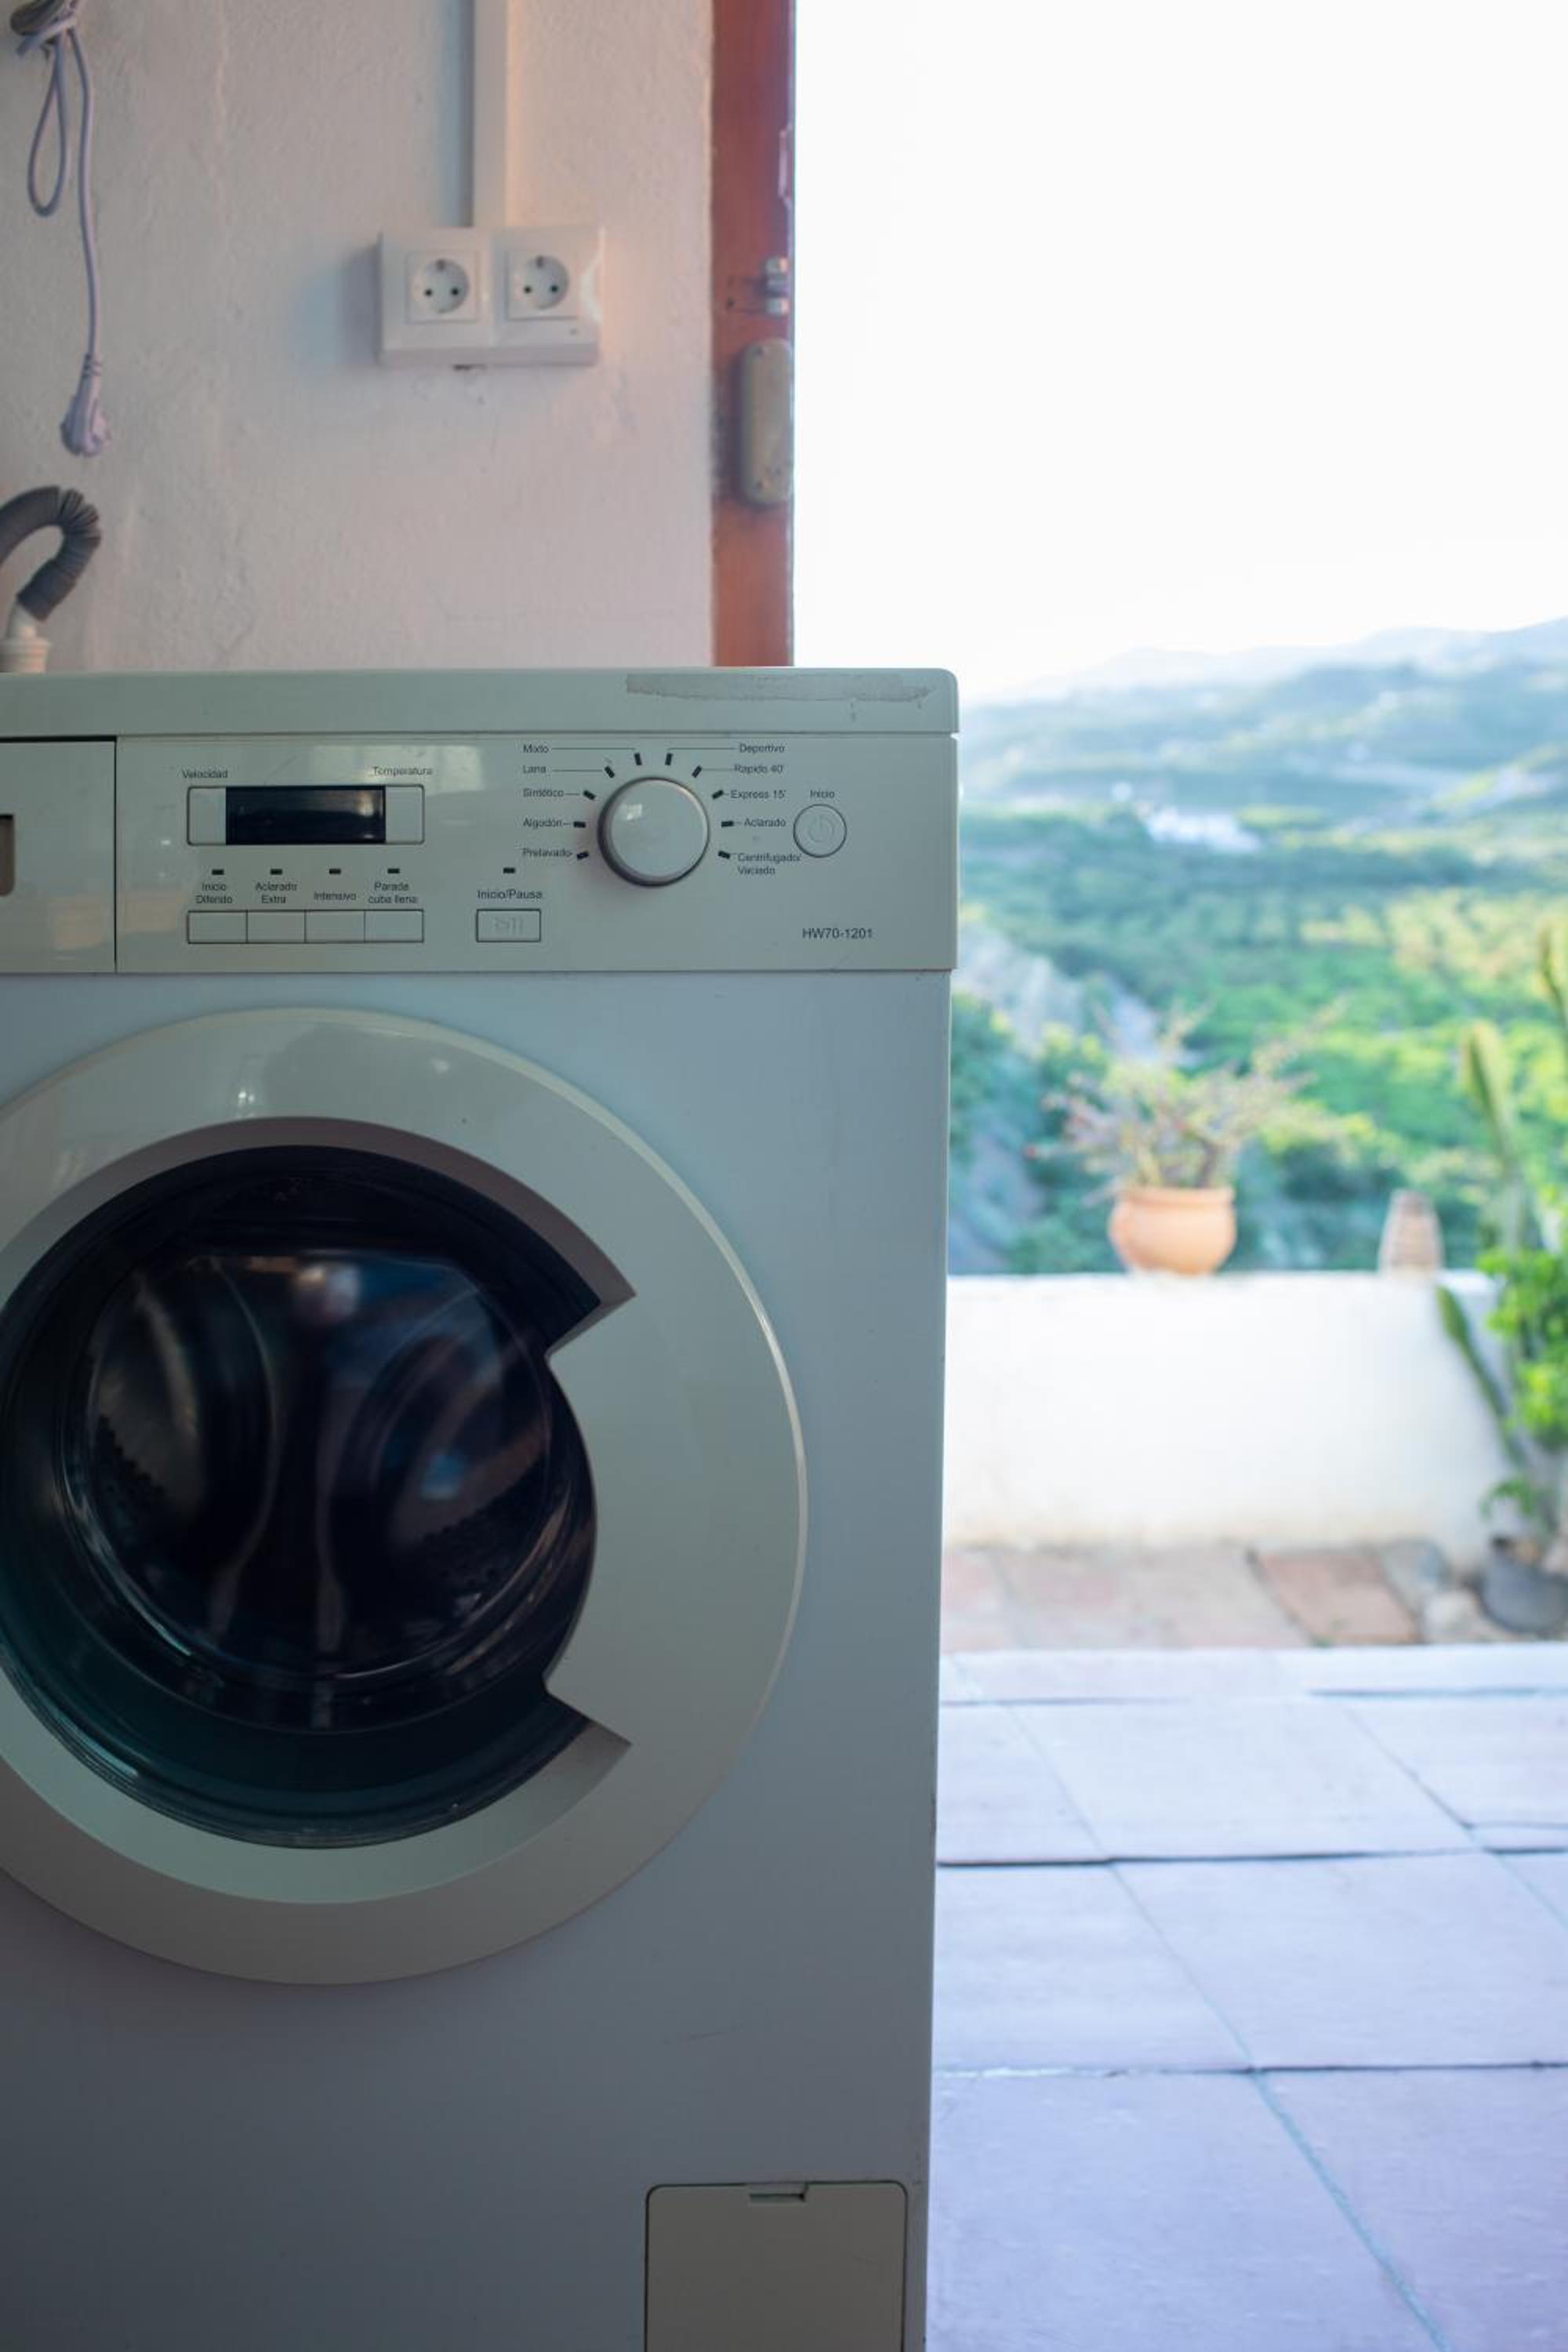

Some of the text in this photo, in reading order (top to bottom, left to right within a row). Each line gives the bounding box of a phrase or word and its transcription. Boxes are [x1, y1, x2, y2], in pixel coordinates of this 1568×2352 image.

[523, 743, 549, 753] Mixto
[739, 742, 785, 754] Deportivo
[181, 768, 228, 778] Velocidad
[373, 765, 434, 777] Temperatura
[523, 765, 546, 774] Lana
[730, 789, 768, 800] Express
[810, 789, 835, 798] Inicio
[744, 818, 786, 827] Aclarado
[522, 847, 572, 857] Prelavado
[738, 865, 775, 875] Vaciado
[201, 881, 227, 891] Inicio
[255, 881, 297, 891] Aclarado
[374, 881, 409, 891] Parada
[261, 894, 286, 904] Extra
[314, 891, 357, 901] Intensivo
[368, 894, 417, 904] cuba llena
[477, 889, 543, 899] Inicio/Pausa
[802, 927, 873, 939] HW70-1201
